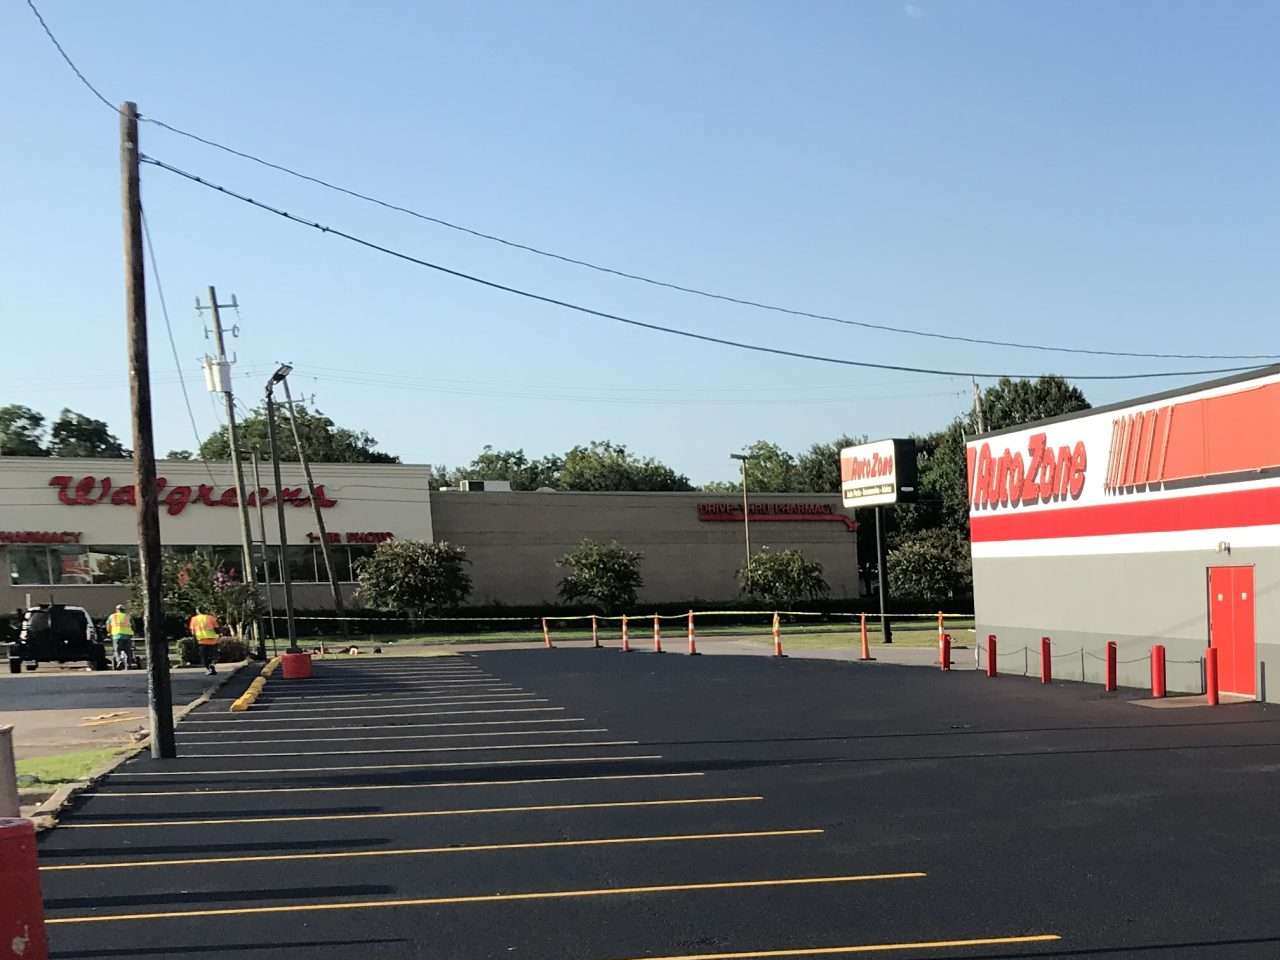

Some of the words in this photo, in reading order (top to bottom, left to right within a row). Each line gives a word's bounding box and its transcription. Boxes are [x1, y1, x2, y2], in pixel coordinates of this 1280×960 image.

[851, 453, 894, 480] AutoZone
[974, 432, 1087, 510] AutoZone
[774, 503, 834, 514] PHARMACY
